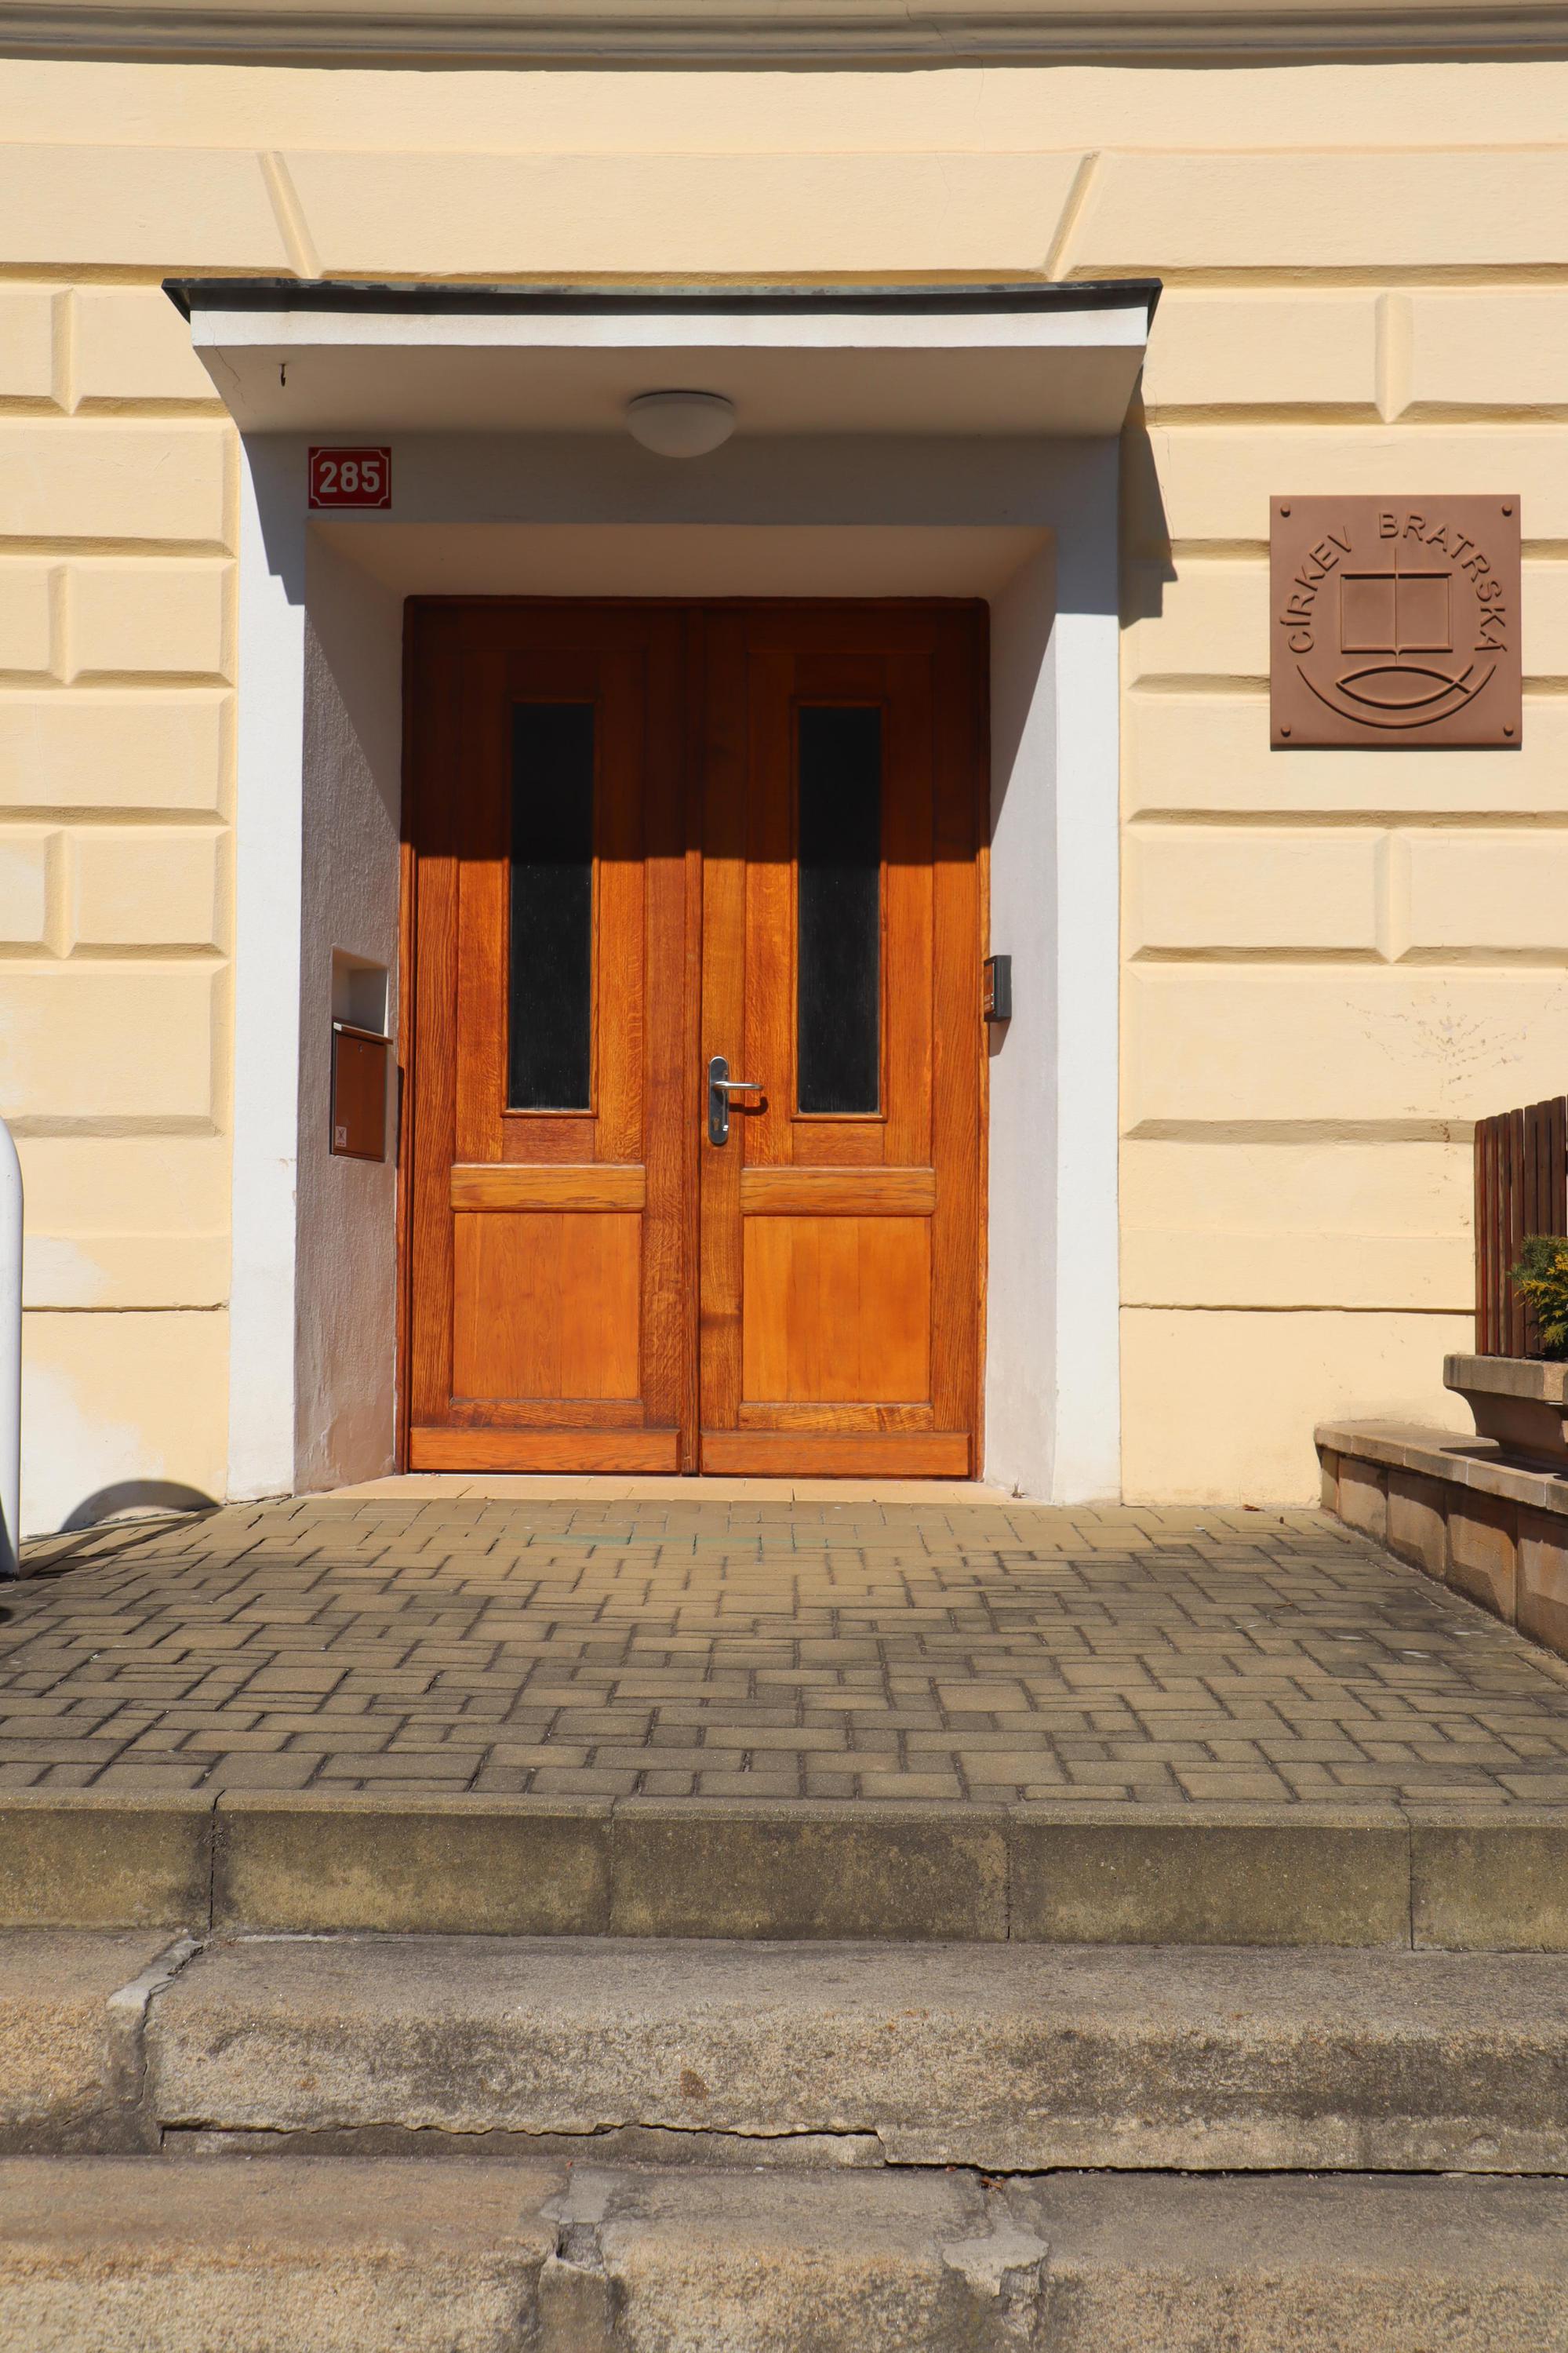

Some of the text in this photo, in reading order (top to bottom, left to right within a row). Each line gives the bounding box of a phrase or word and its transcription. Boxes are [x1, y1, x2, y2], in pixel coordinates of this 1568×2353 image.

[319, 461, 380, 493] 285
[1279, 512, 1508, 653] CÍRKEV BRATRSKÁ
